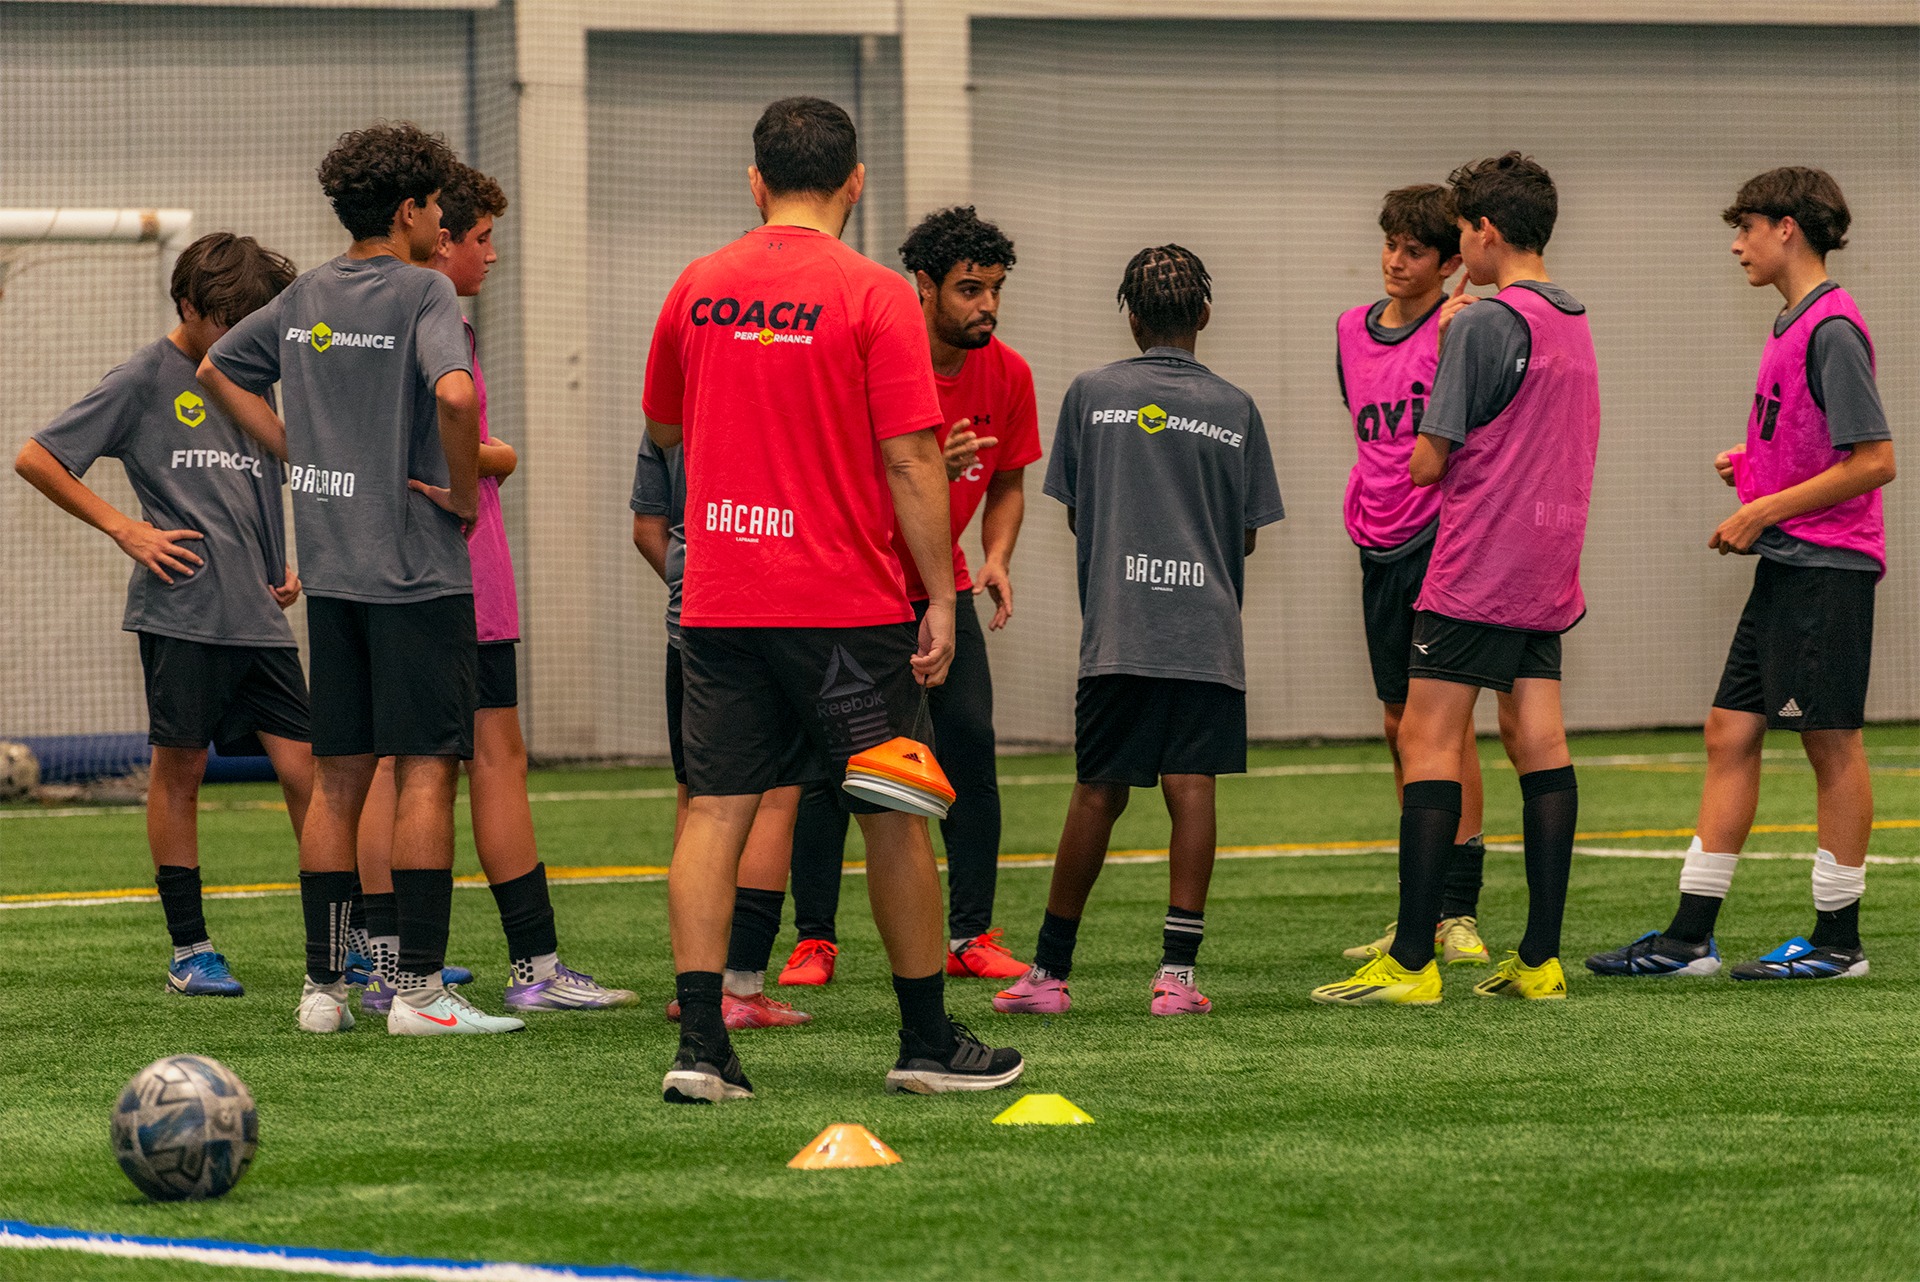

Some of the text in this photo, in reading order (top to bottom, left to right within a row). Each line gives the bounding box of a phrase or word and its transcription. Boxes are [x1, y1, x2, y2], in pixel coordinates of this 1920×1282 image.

[691, 297, 824, 331] COACH
[706, 499, 794, 538] BĀCARO
[1125, 553, 1205, 588] BĀCARO
[816, 691, 886, 718] Reebok
